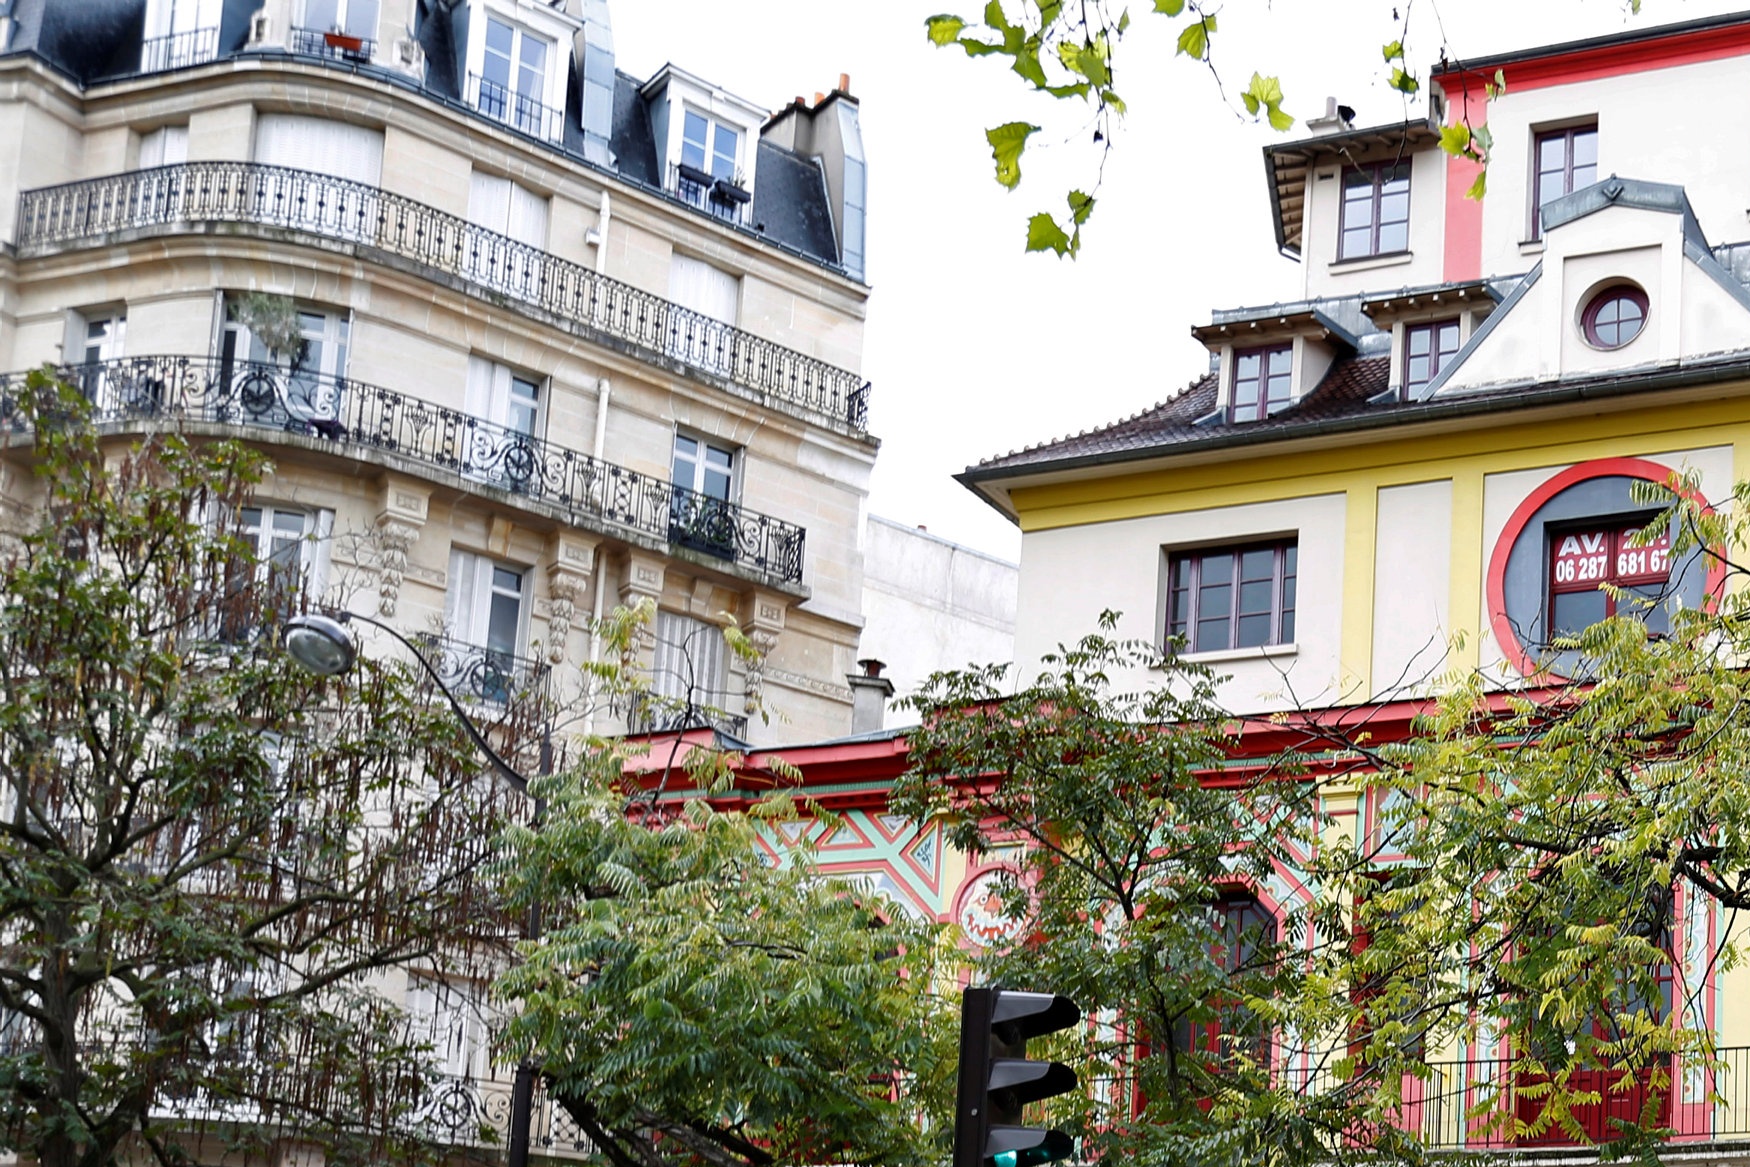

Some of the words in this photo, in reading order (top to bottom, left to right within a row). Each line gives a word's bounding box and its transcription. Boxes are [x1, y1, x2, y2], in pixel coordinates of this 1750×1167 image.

[1558, 532, 1605, 557] AV.
[1556, 560, 1575, 582] 06
[1578, 555, 1607, 580] 287
[1618, 551, 1646, 576] 681
[1650, 548, 1670, 573] 67
